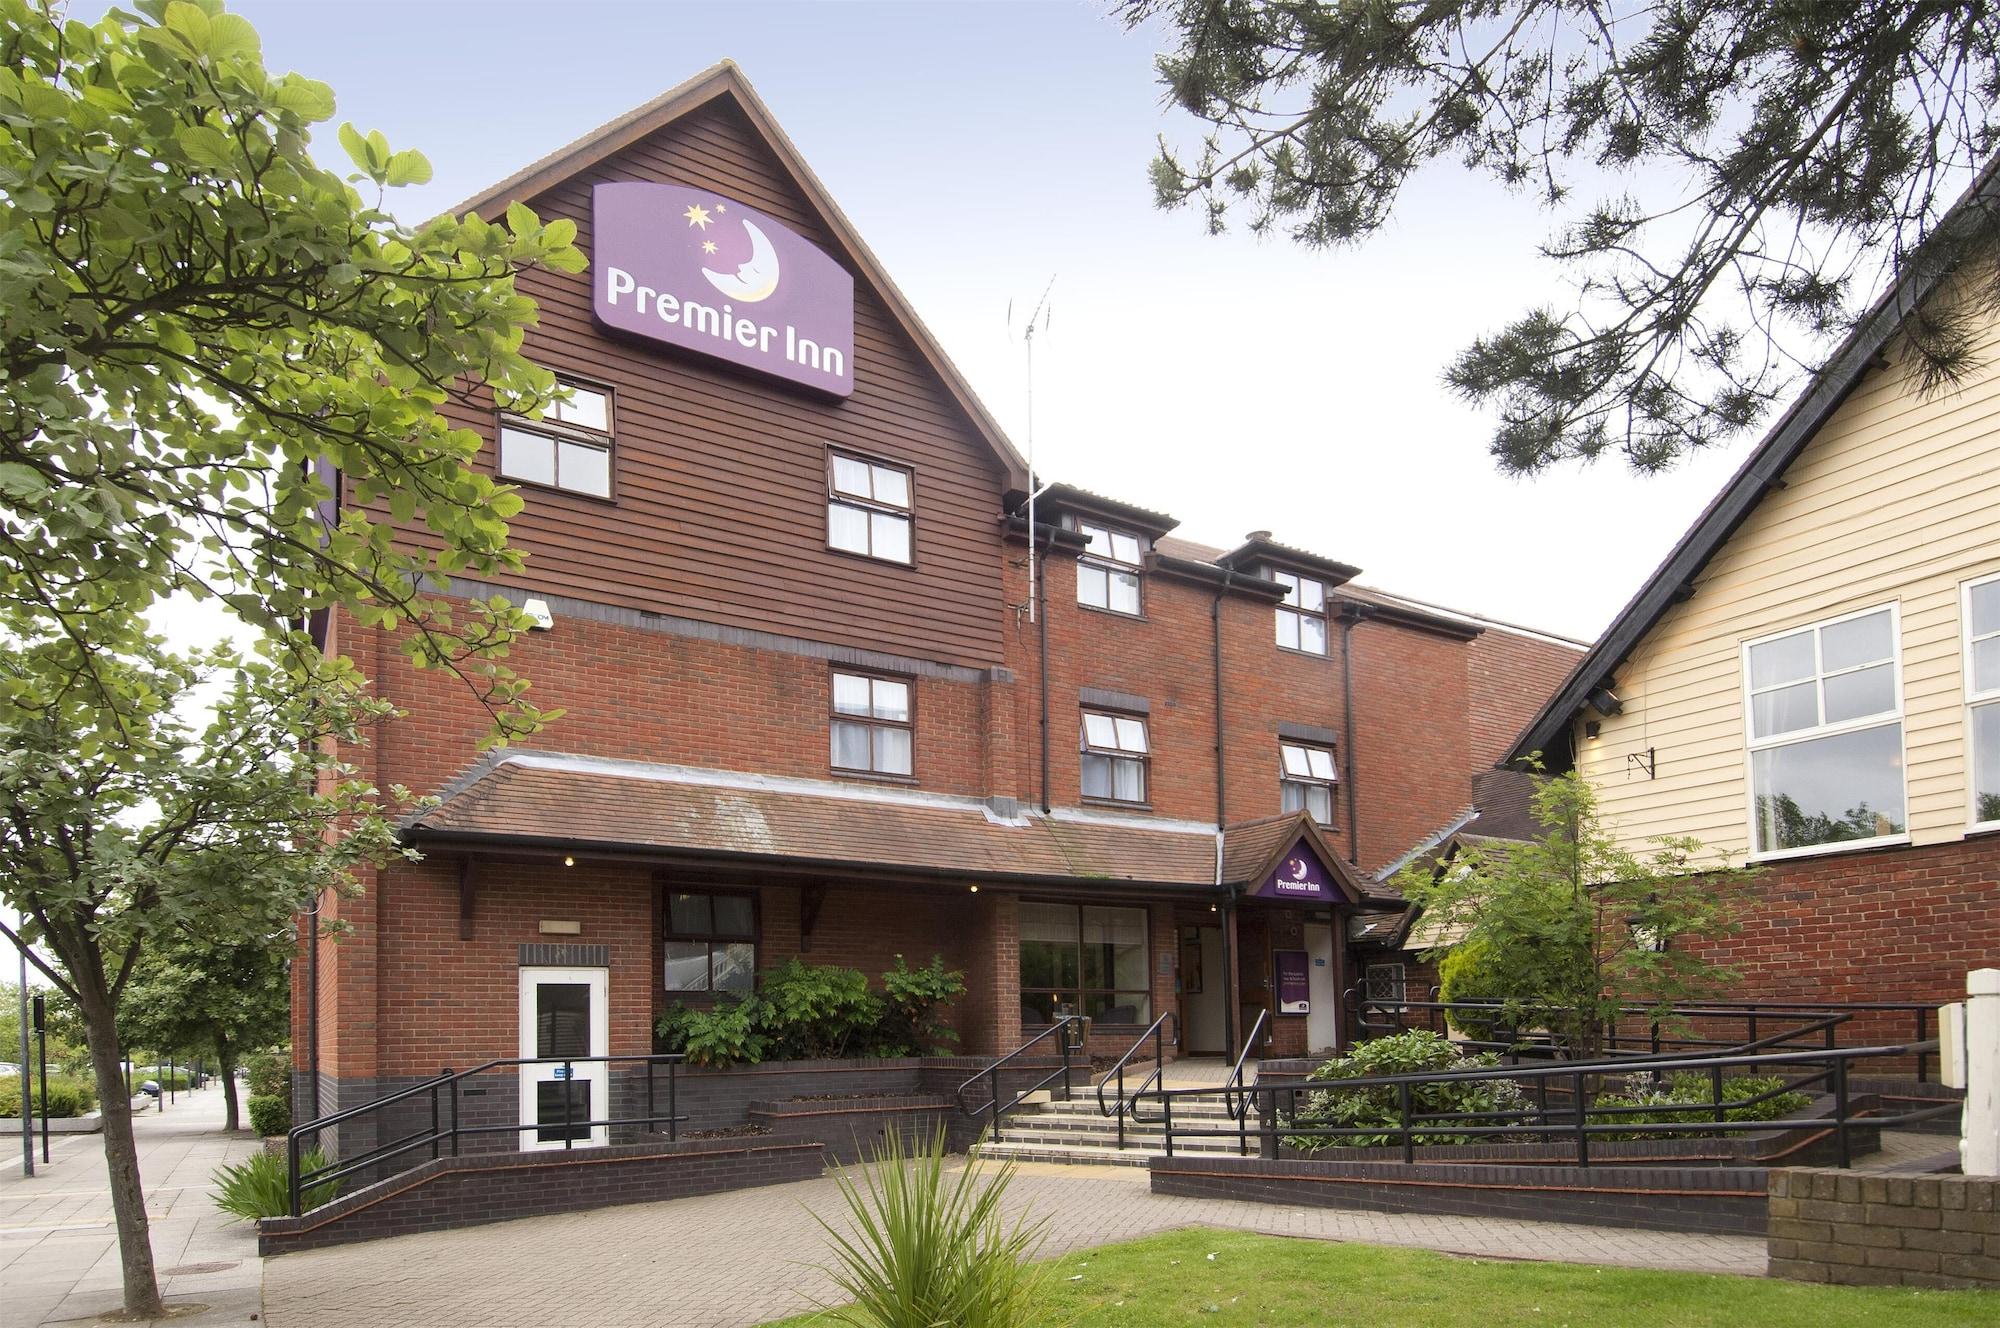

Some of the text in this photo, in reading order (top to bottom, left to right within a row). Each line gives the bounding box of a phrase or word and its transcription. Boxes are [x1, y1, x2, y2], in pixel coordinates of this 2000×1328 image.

[607, 267, 844, 377] Premier Inn
[1277, 879, 1320, 892] Premier Inn
